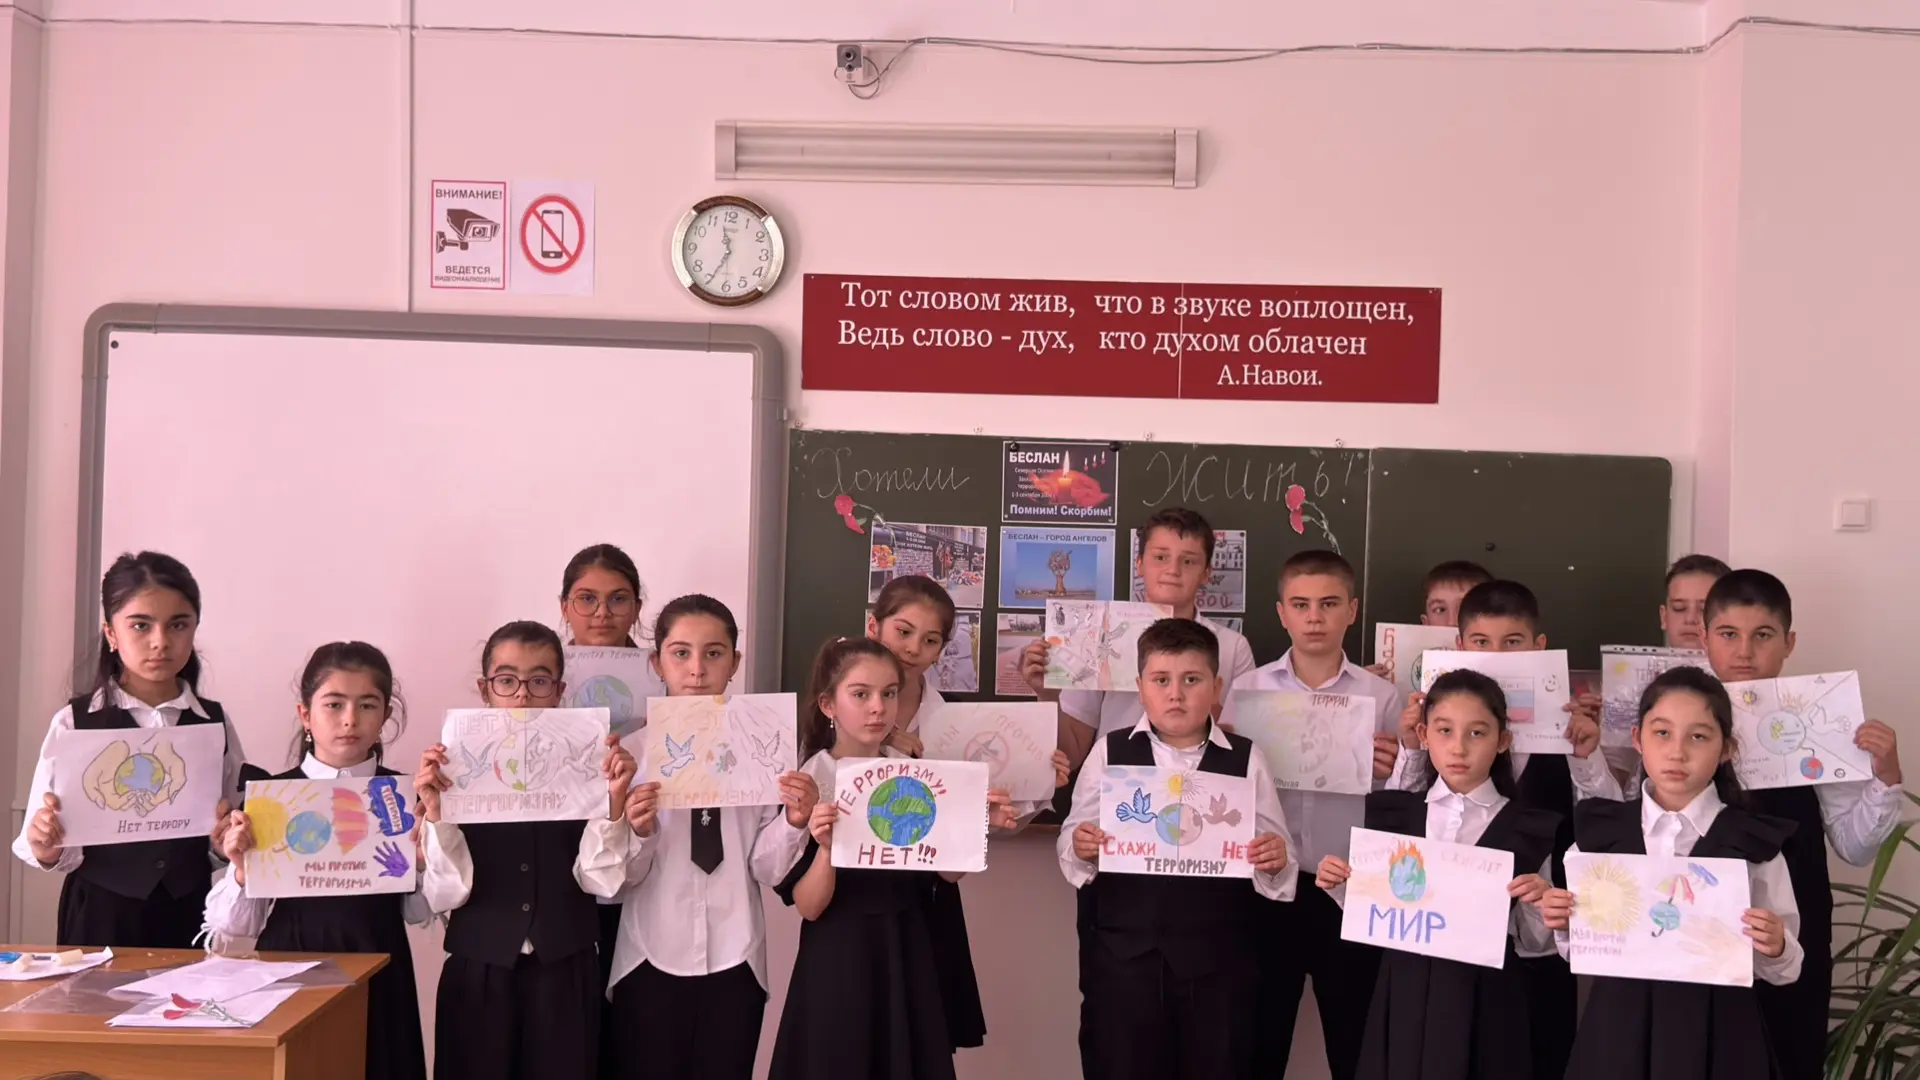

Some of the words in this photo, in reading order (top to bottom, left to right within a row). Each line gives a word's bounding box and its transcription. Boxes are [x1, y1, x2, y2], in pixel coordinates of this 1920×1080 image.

[435, 188, 502, 200] ВНИМАНИЕ!
[724, 211, 738, 224] 12
[755, 231, 765, 243] 2
[687, 242, 698, 255] 9
[758, 248, 769, 261] 3
[445, 265, 491, 275] ВЕДЕТСЯ
[692, 259, 703, 273] 8
[752, 266, 763, 278] 4
[721, 280, 731, 293] 6
[737, 276, 748, 288] 5
[841, 281, 892, 308] Тот
[899, 290, 1001, 311] словом
[1008, 293, 1076, 318] жив,
[1094, 294, 1142, 315] что
[1150, 296, 1166, 315] в
[1173, 296, 1252, 323] звуке
[1259, 299, 1415, 325] воплощен,
[837, 319, 905, 350] Ведь
[911, 328, 993, 348] слово
[1018, 330, 1075, 355] дух,
[1099, 331, 1146, 351] кто
[1153, 332, 1241, 358] духом
[1248, 327, 1368, 356] облачен
[1217, 364, 1323, 386] А.Навои.
[1009, 451, 1060, 464] БЕСЛАН
[811, 447, 970, 499] Хотели
[1010, 504, 1058, 516] Помним!
[1060, 505, 1112, 518] Скорбим!
[1008, 533, 1039, 541] БЕСЛАН
[1046, 533, 1070, 541] ГОРОД
[1072, 533, 1107, 542] АНГЕЛОВ
[858, 843, 937, 865] НЕТ!!!
[1368, 903, 1446, 944] МИР
